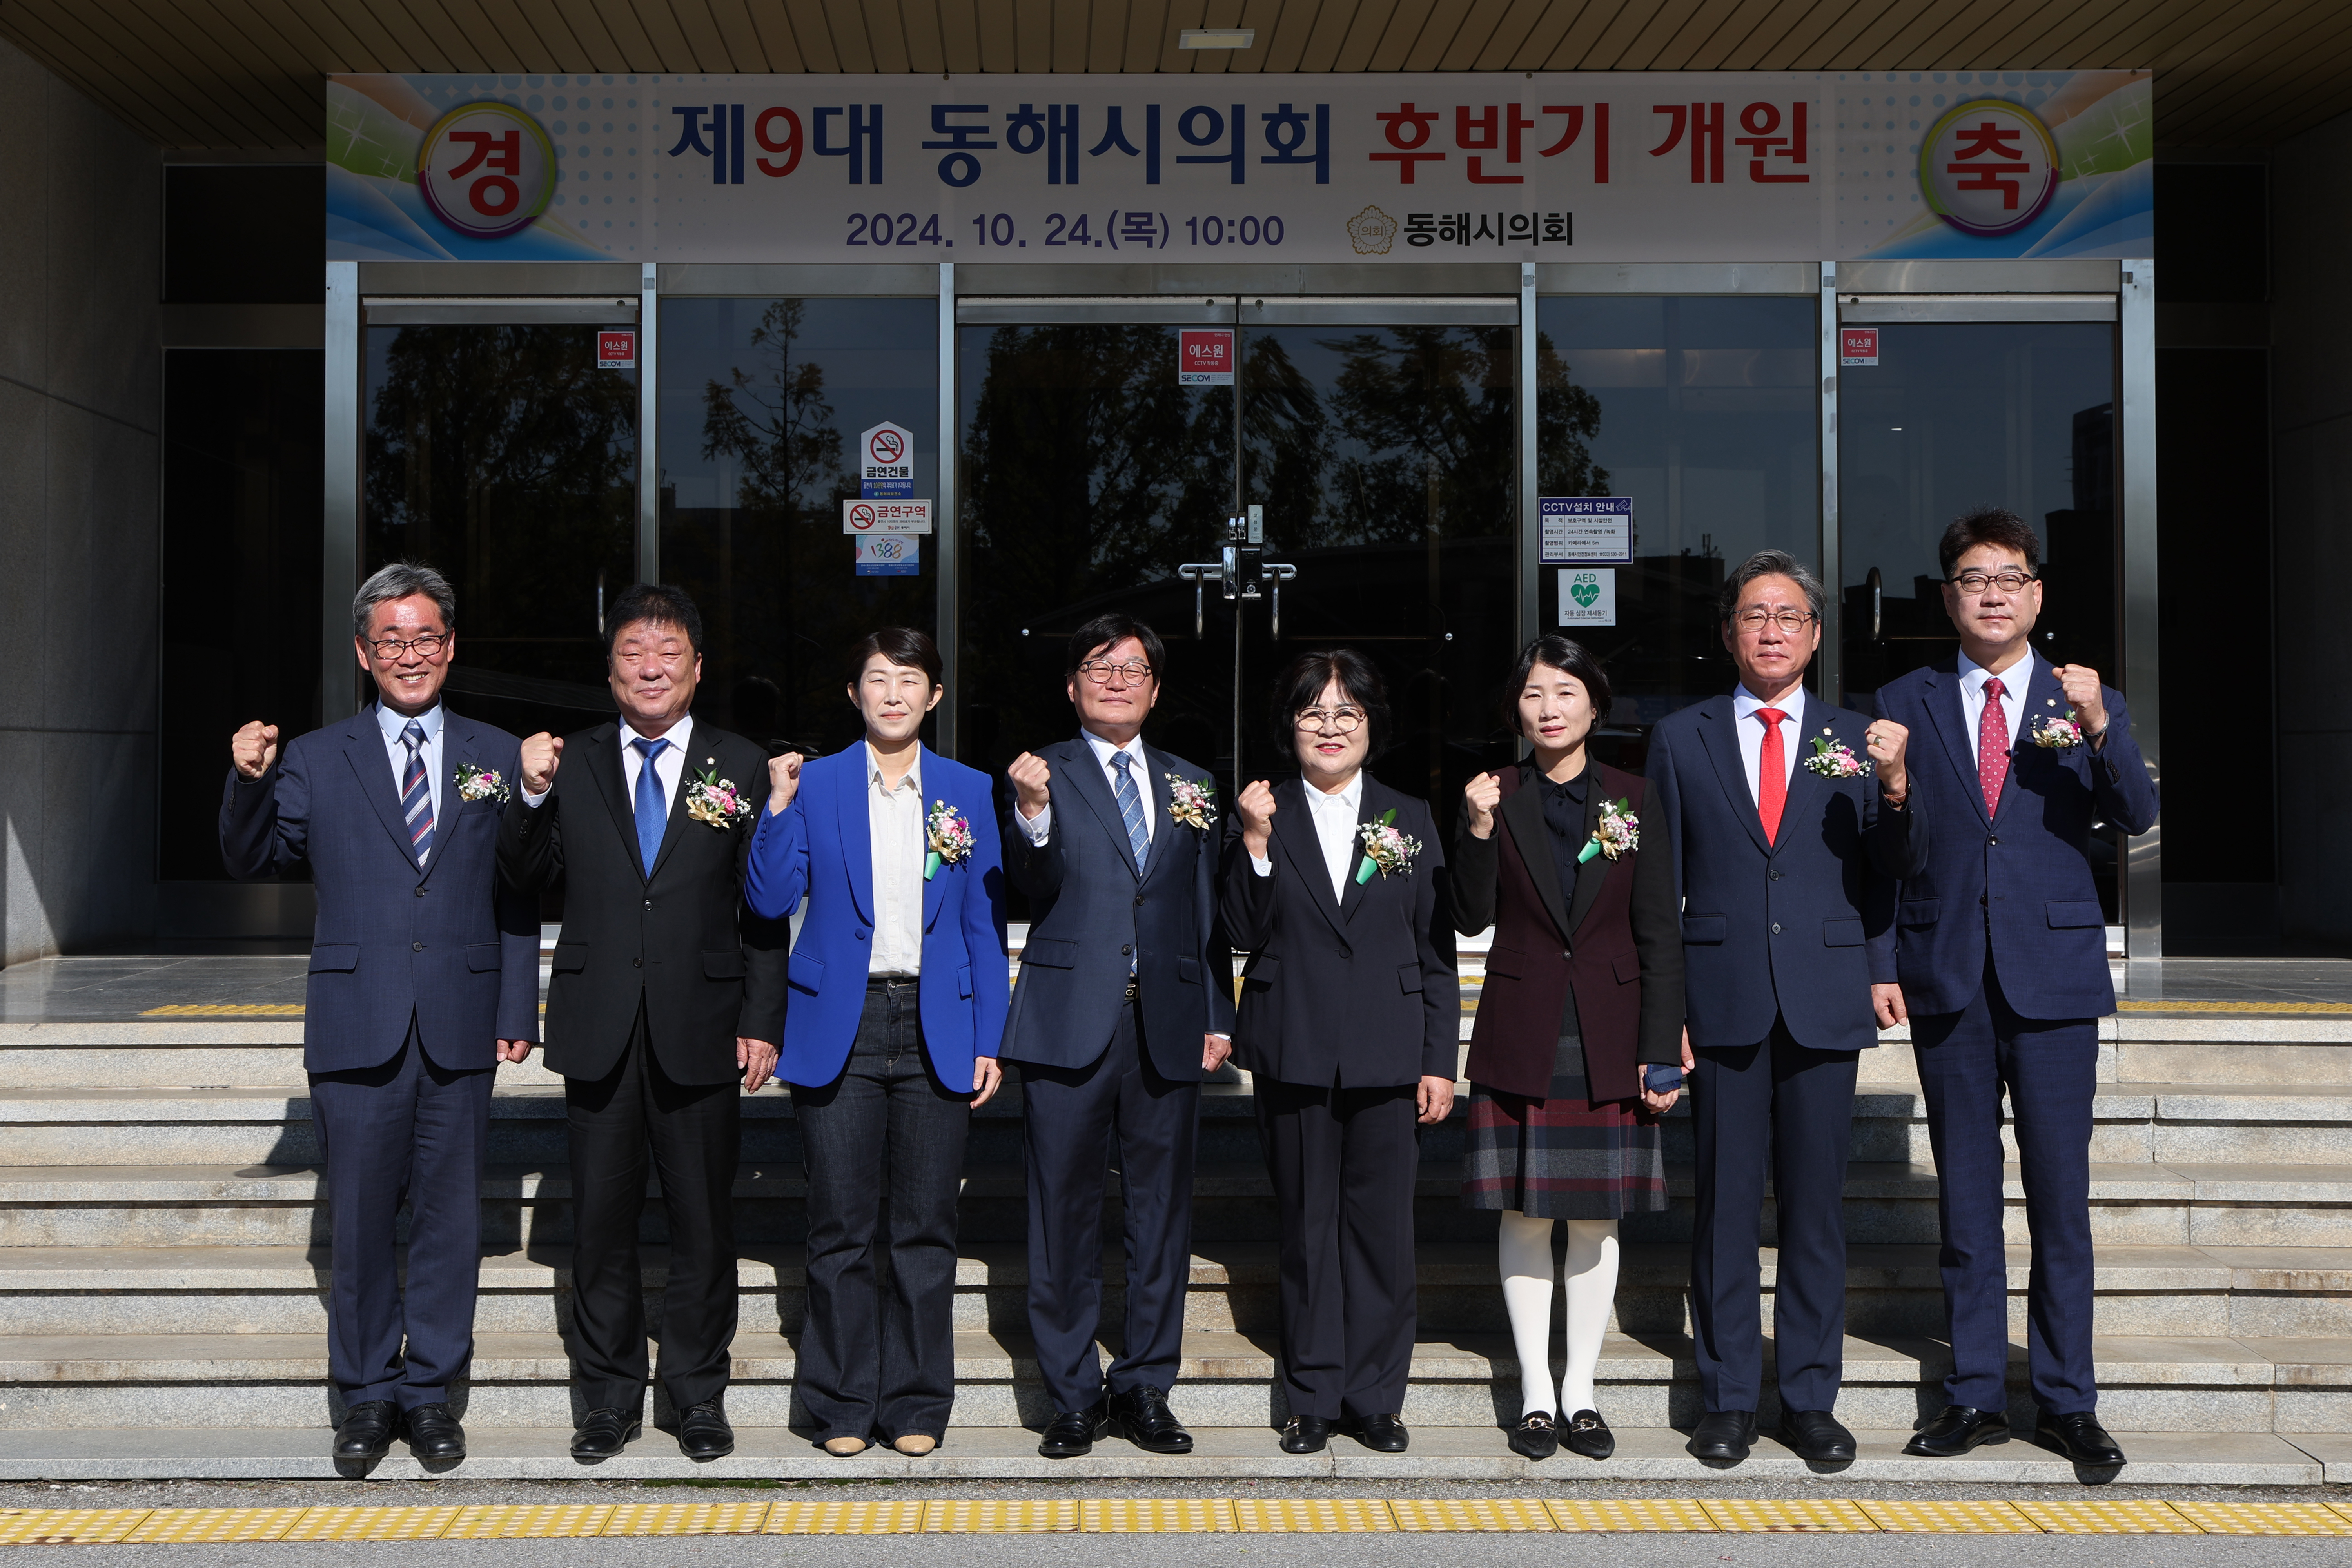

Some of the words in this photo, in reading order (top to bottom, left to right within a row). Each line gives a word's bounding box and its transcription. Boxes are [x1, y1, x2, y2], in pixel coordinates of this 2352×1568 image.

[668, 104, 883, 185] 제9대
[922, 103, 1330, 188] 동해시의회
[1369, 103, 1609, 184] 후반기
[1648, 102, 1809, 183] 개원
[1947, 122, 2030, 210] 축
[448, 131, 520, 217] 경
[846, 213, 953, 247] 2024.
[973, 213, 1026, 247] 10.
[1045, 210, 1169, 250] 24.(목)
[1185, 216, 1284, 246] 10:00
[1361, 225, 1383, 237] 의회
[1404, 212, 1573, 247] 동해시의회
[604, 341, 628, 350] 에스원
[1848, 338, 1871, 347] 에스원
[1189, 344, 1223, 358] 에스원
[866, 466, 909, 478] 금연건물
[877, 506, 925, 518] 금연구역
[1543, 502, 1592, 512] CCTV설치
[1595, 502, 1614, 512] 안내
[871, 543, 902, 559] 1388
[1574, 573, 1597, 583] AED
